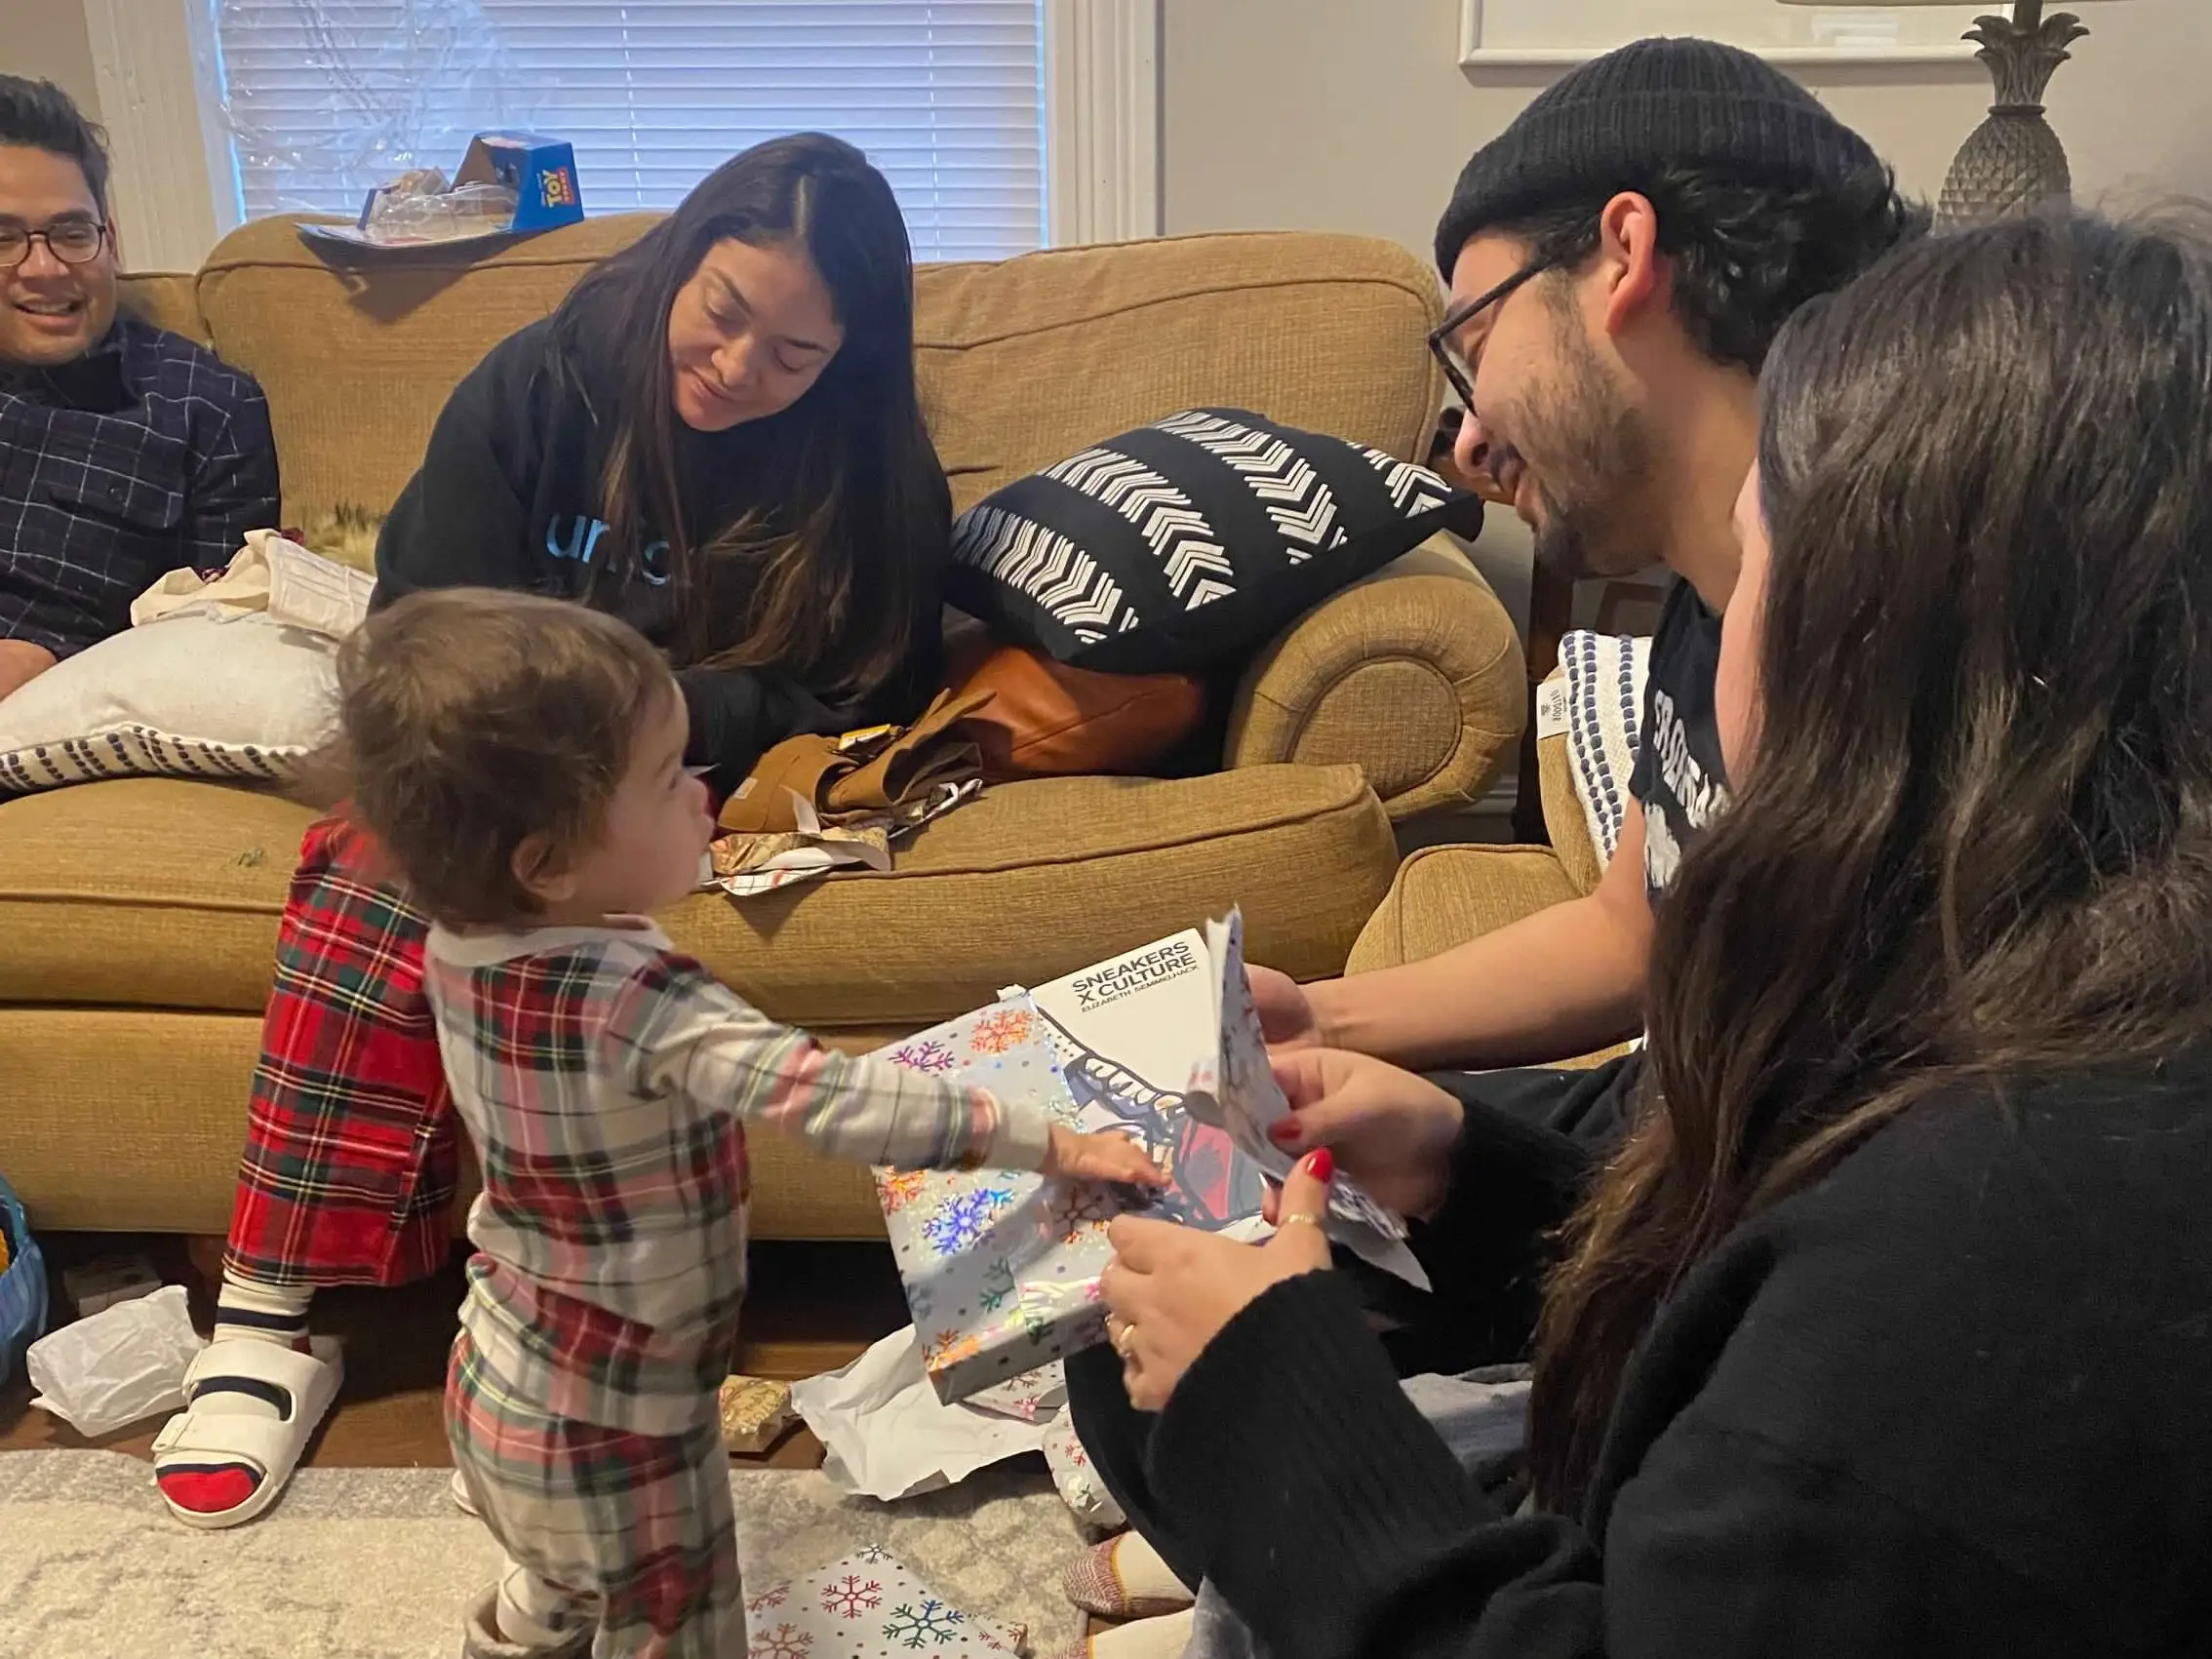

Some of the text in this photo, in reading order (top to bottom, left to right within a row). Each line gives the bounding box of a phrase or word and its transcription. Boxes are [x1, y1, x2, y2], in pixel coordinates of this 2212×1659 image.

[542, 169, 563, 208] TOY
[1072, 941, 1190, 992] SNEAKERS
[1077, 952, 1197, 1006] X CULTURE
[1081, 989, 1132, 1013] ELIZABETH
